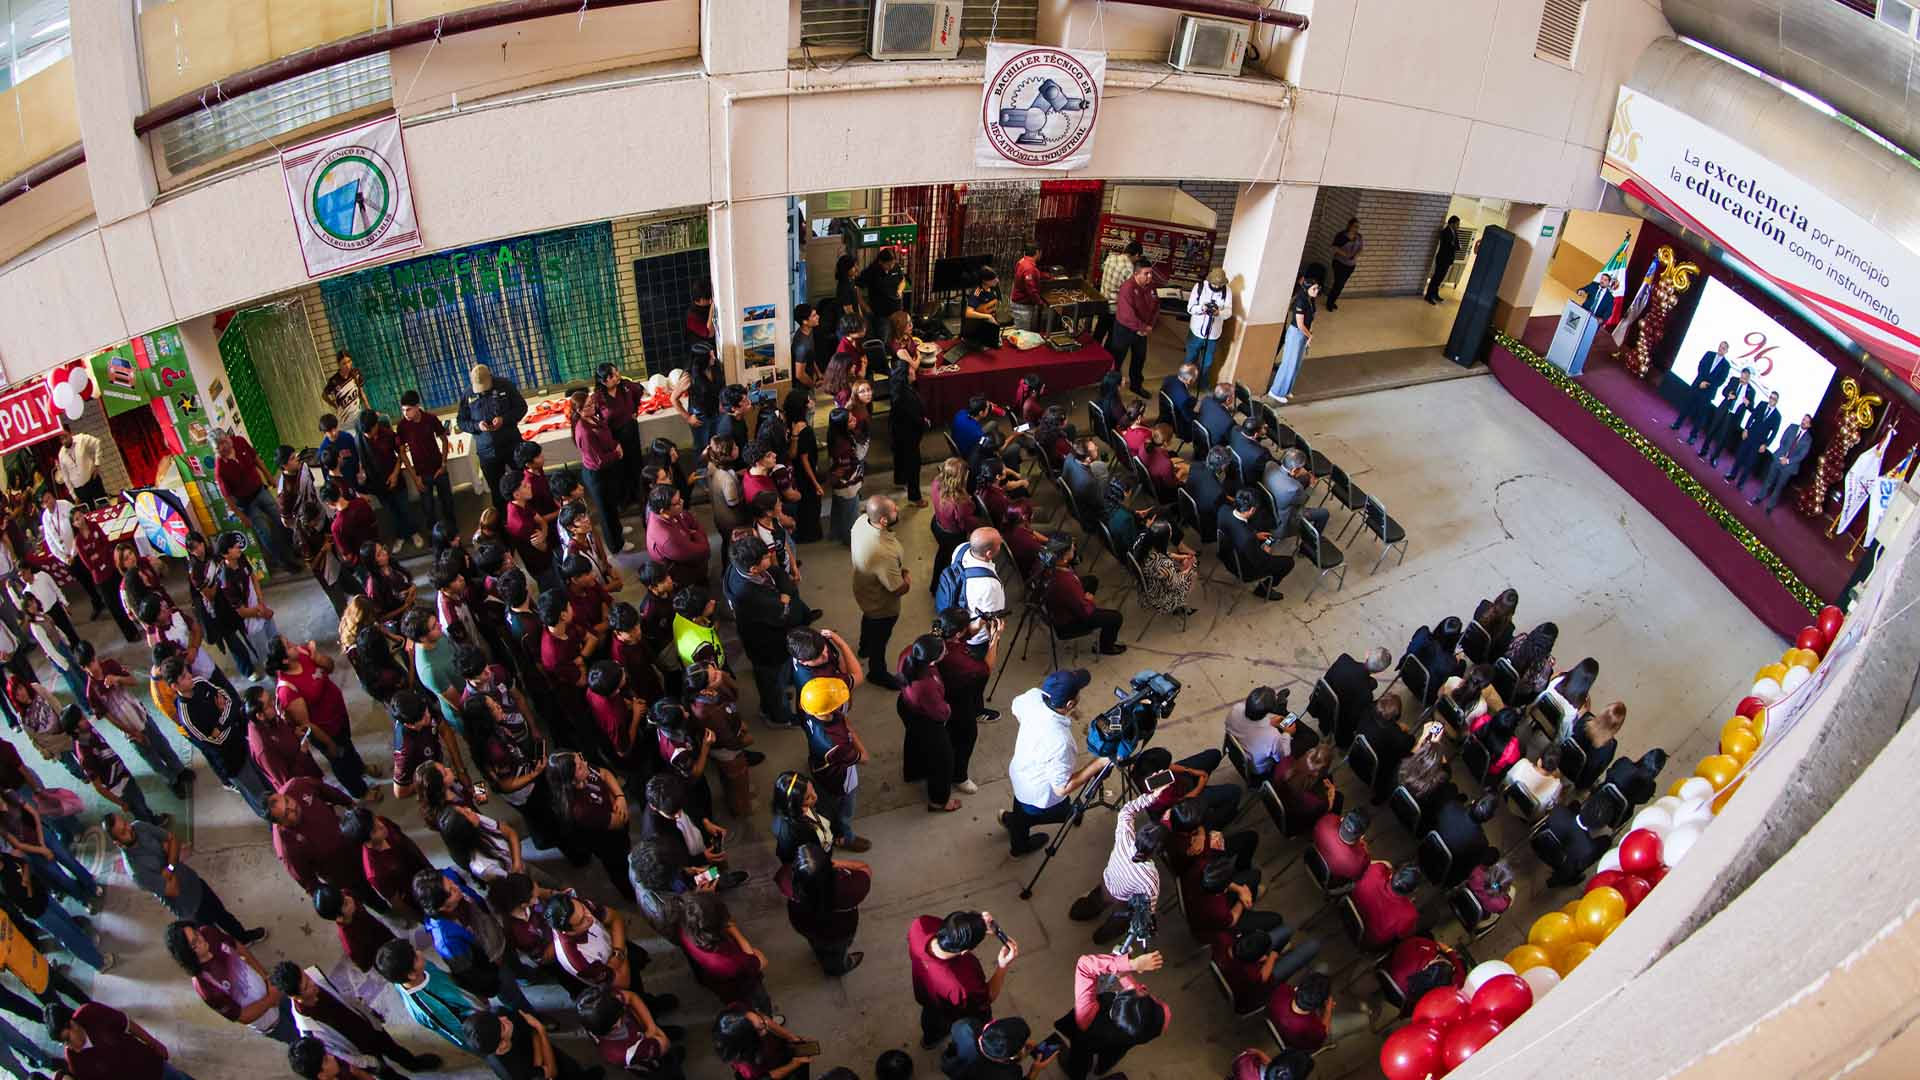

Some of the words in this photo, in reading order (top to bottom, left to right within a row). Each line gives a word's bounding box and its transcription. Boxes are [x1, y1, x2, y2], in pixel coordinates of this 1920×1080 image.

[994, 55, 1040, 96] BACHILLER
[1043, 54, 1083, 80] TÉCNICO
[1081, 80, 1092, 95] EN
[355, 148, 366, 156] EN
[990, 121, 1039, 161] MECATRÓNICA
[1041, 127, 1087, 161] INDUSTRIAL
[356, 213, 393, 247] RENOVABLES
[1683, 149, 1700, 168] La
[1704, 160, 1809, 232] excelencia
[1811, 227, 1834, 248] por
[1835, 243, 1890, 288] principio
[1670, 166, 1682, 182] la
[1685, 174, 1787, 245] educación
[1788, 240, 1824, 271] como
[1826, 264, 1901, 326] instrumento
[1737, 331, 1780, 376] 96
[0, 395, 52, 441] POLY
